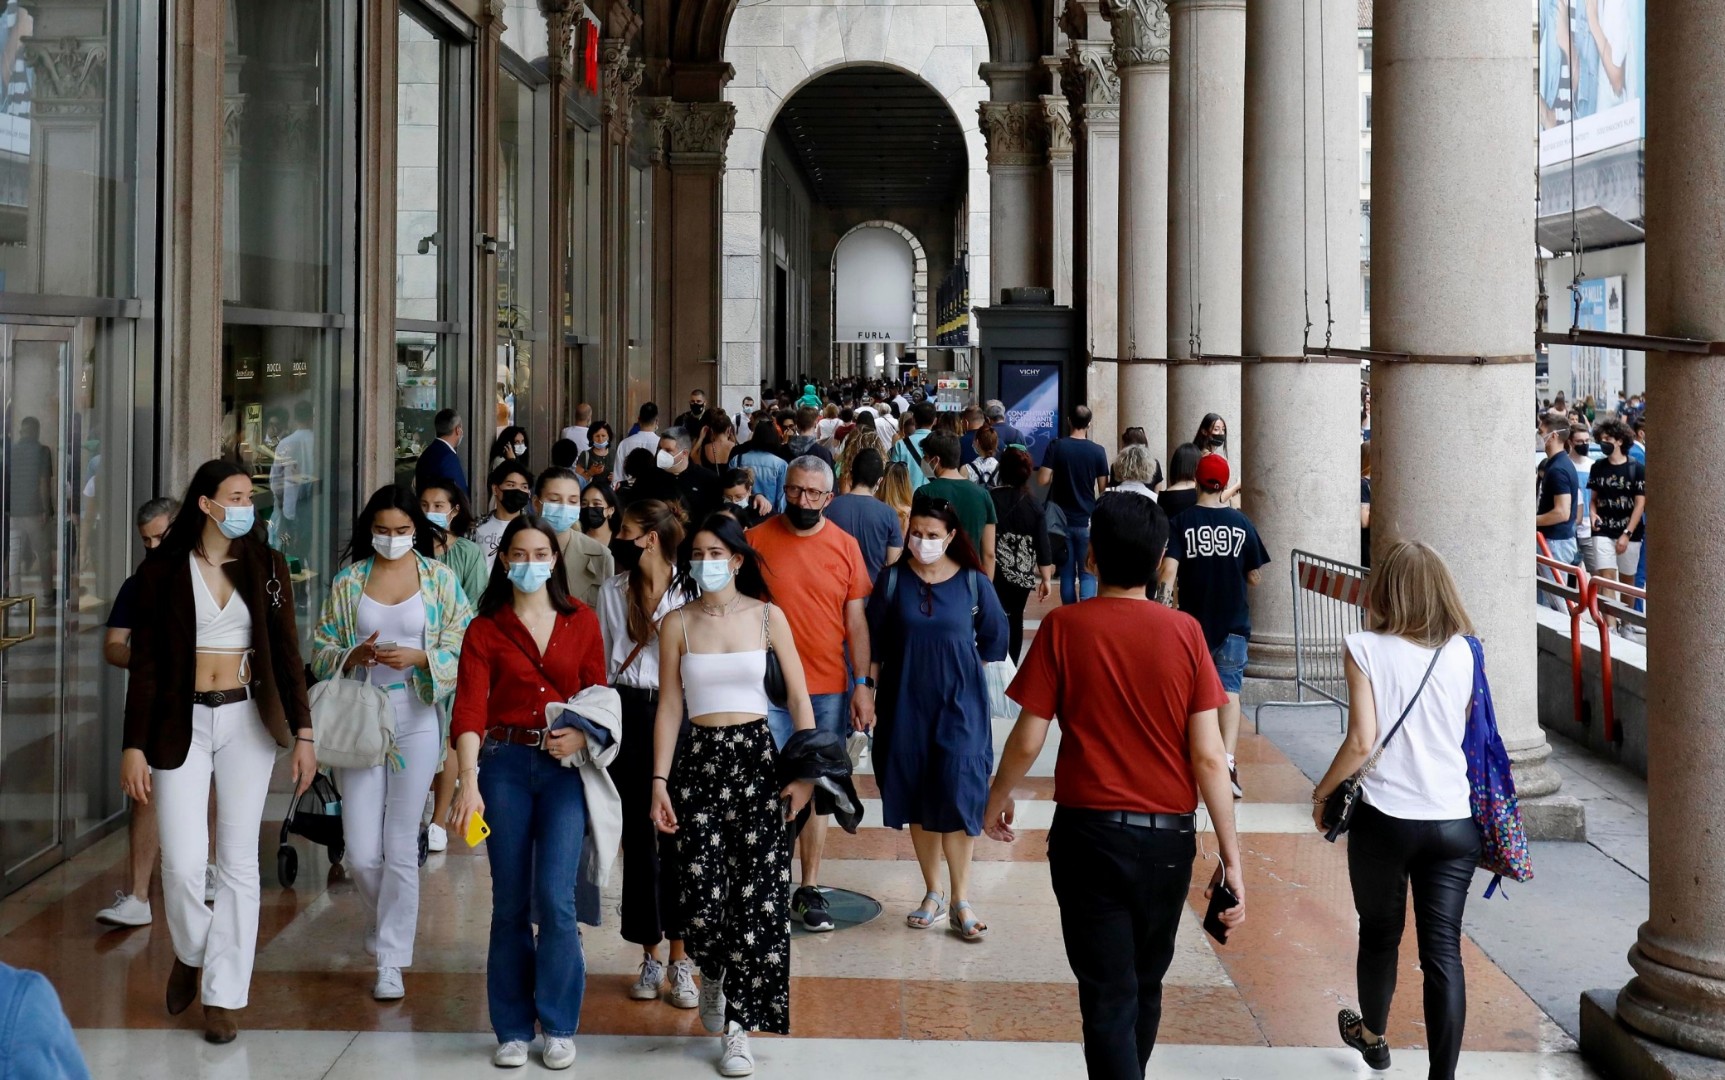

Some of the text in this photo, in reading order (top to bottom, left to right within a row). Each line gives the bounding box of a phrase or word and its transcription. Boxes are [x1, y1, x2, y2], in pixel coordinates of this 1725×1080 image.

[858, 331, 891, 339] FURLA
[266, 363, 282, 372] ROCCA
[292, 362, 307, 371] ROCCA
[1184, 525, 1246, 559] 1997
